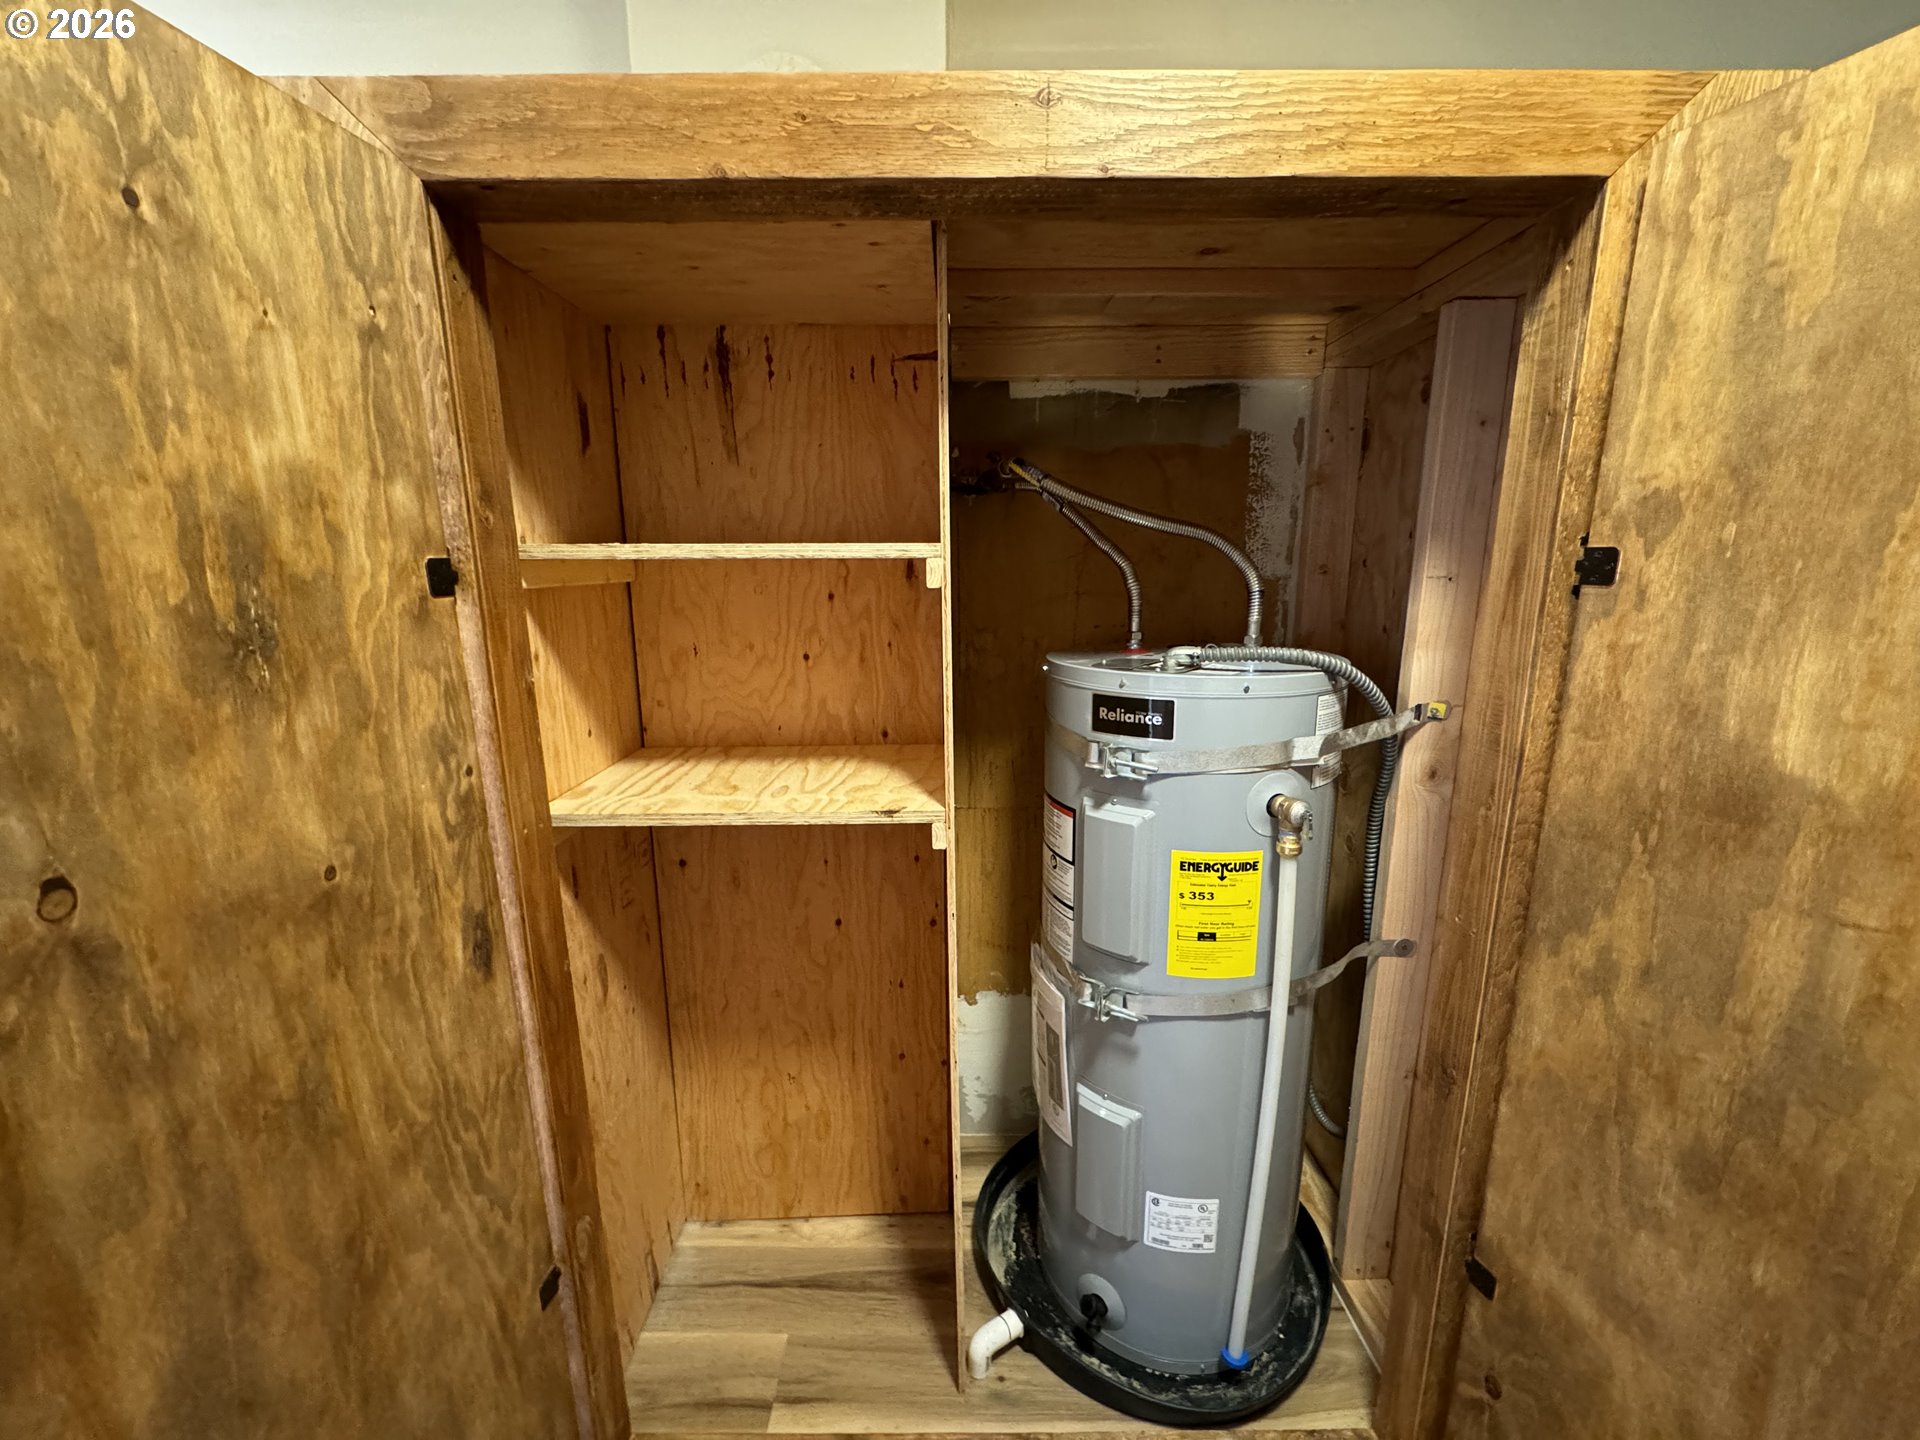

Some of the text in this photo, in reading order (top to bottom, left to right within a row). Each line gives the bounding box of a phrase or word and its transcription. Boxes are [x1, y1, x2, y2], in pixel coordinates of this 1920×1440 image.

[1099, 706, 1163, 726] Reliance
[1179, 861, 1260, 874] ENERGYGUIDE
[1188, 891, 1215, 901] 353
